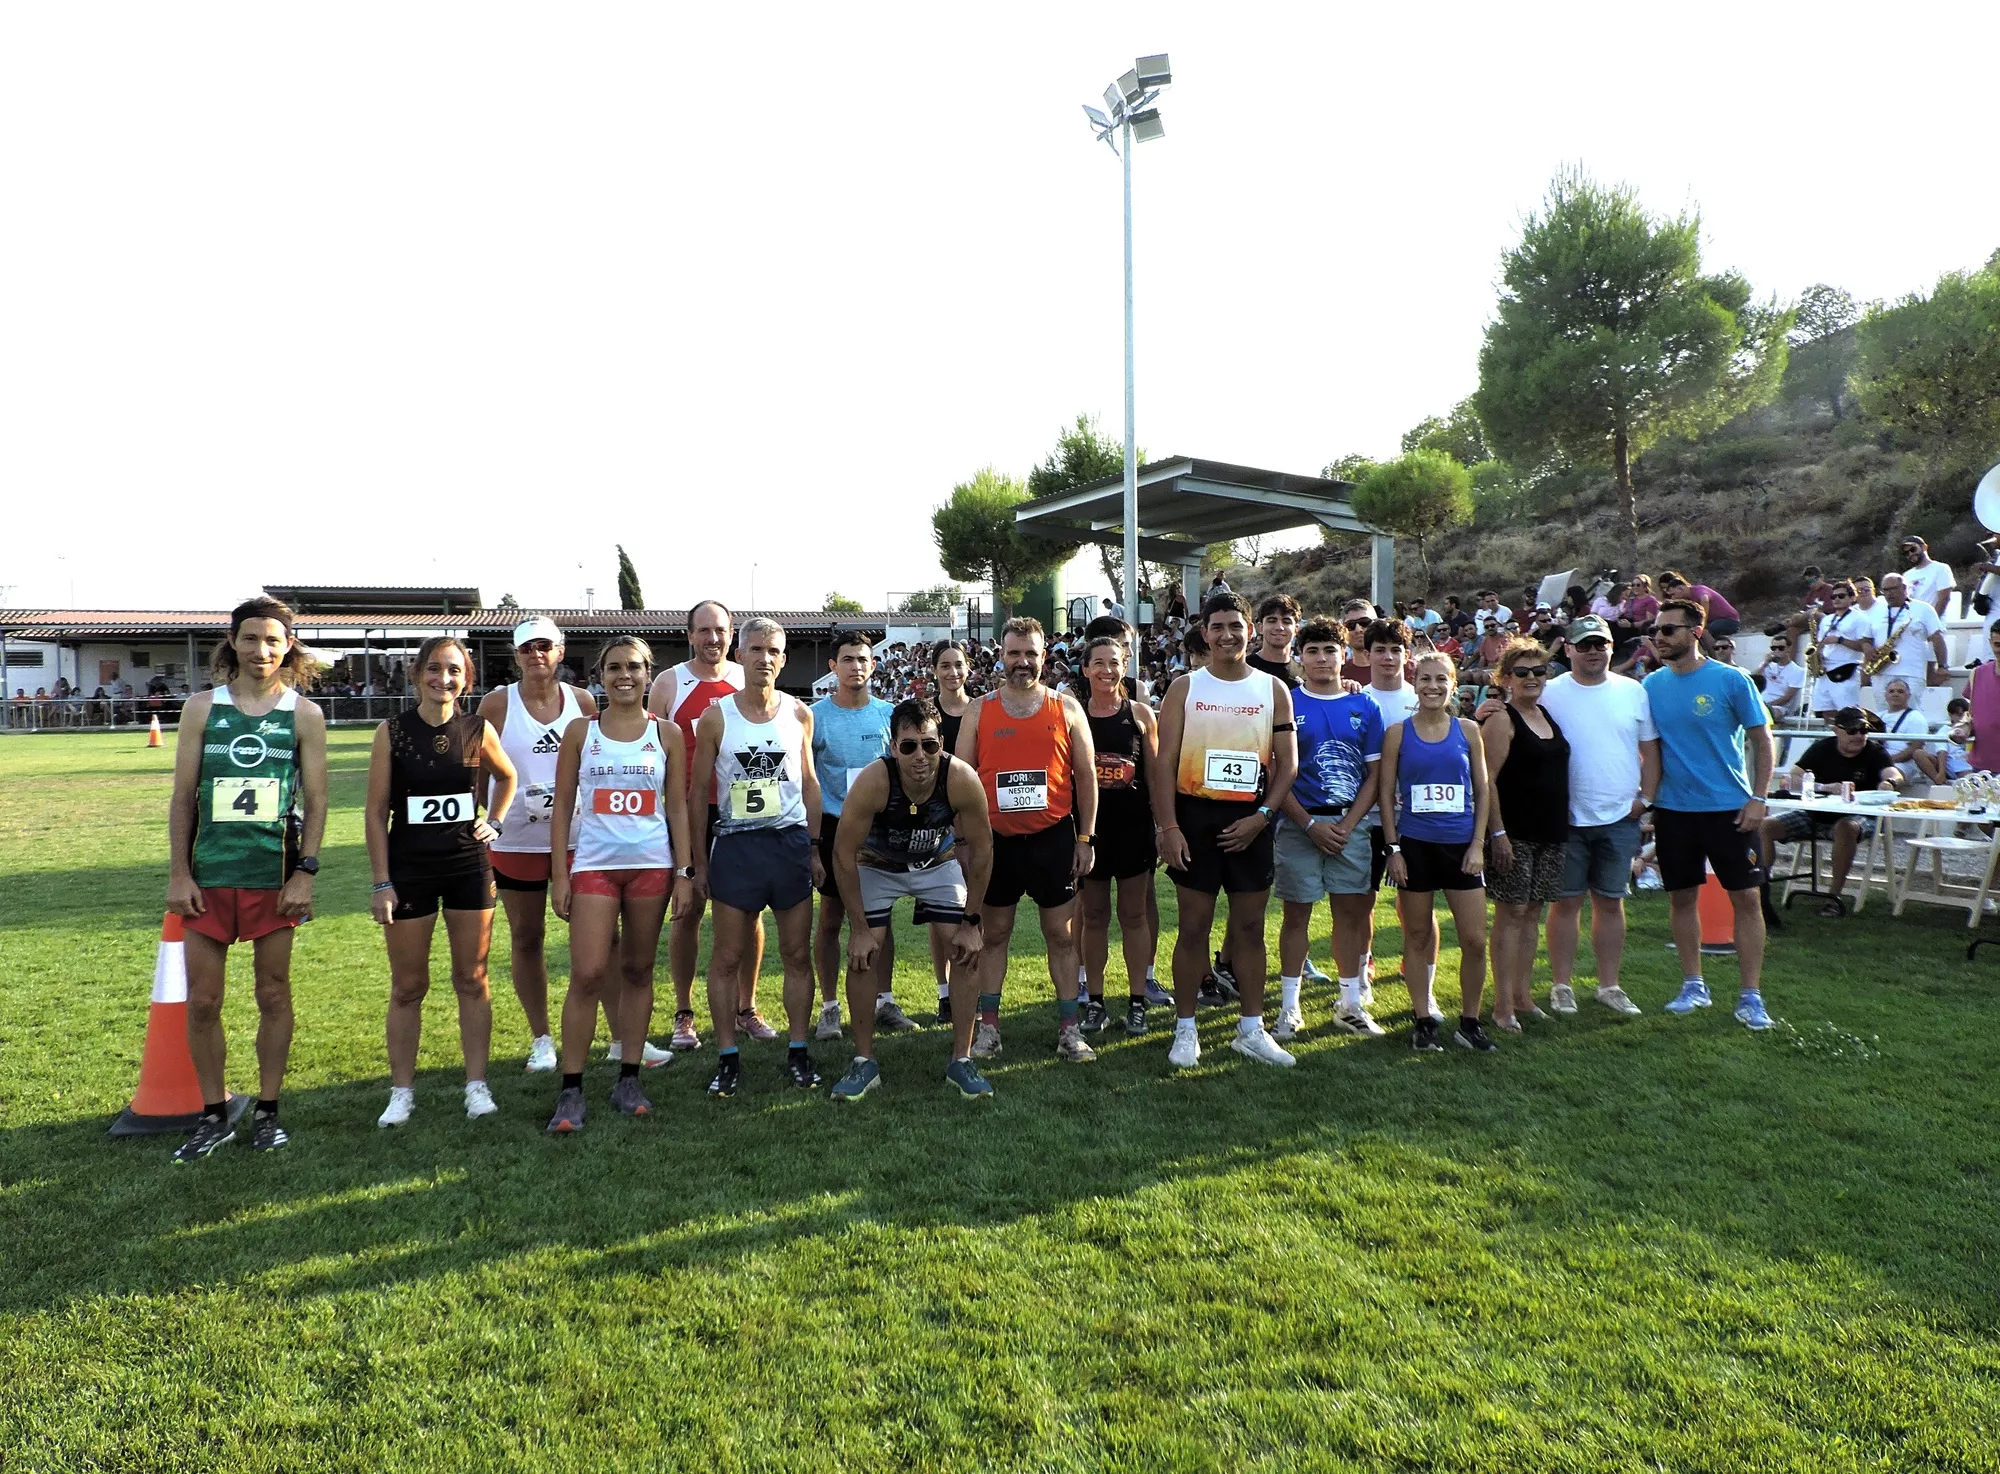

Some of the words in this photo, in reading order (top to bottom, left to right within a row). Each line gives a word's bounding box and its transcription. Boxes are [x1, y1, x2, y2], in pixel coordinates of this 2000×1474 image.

[532, 744, 560, 754] adid
[622, 765, 655, 776] ZUERA
[1096, 766, 1124, 780] 258
[1222, 763, 1242, 776] 43
[1008, 786, 1036, 795] NESTOR
[1423, 785, 1456, 801] 130
[232, 789, 259, 816] 4
[609, 791, 643, 814] 80
[746, 789, 766, 814] 5
[1013, 796, 1031, 807] 300
[422, 797, 461, 823] 20
